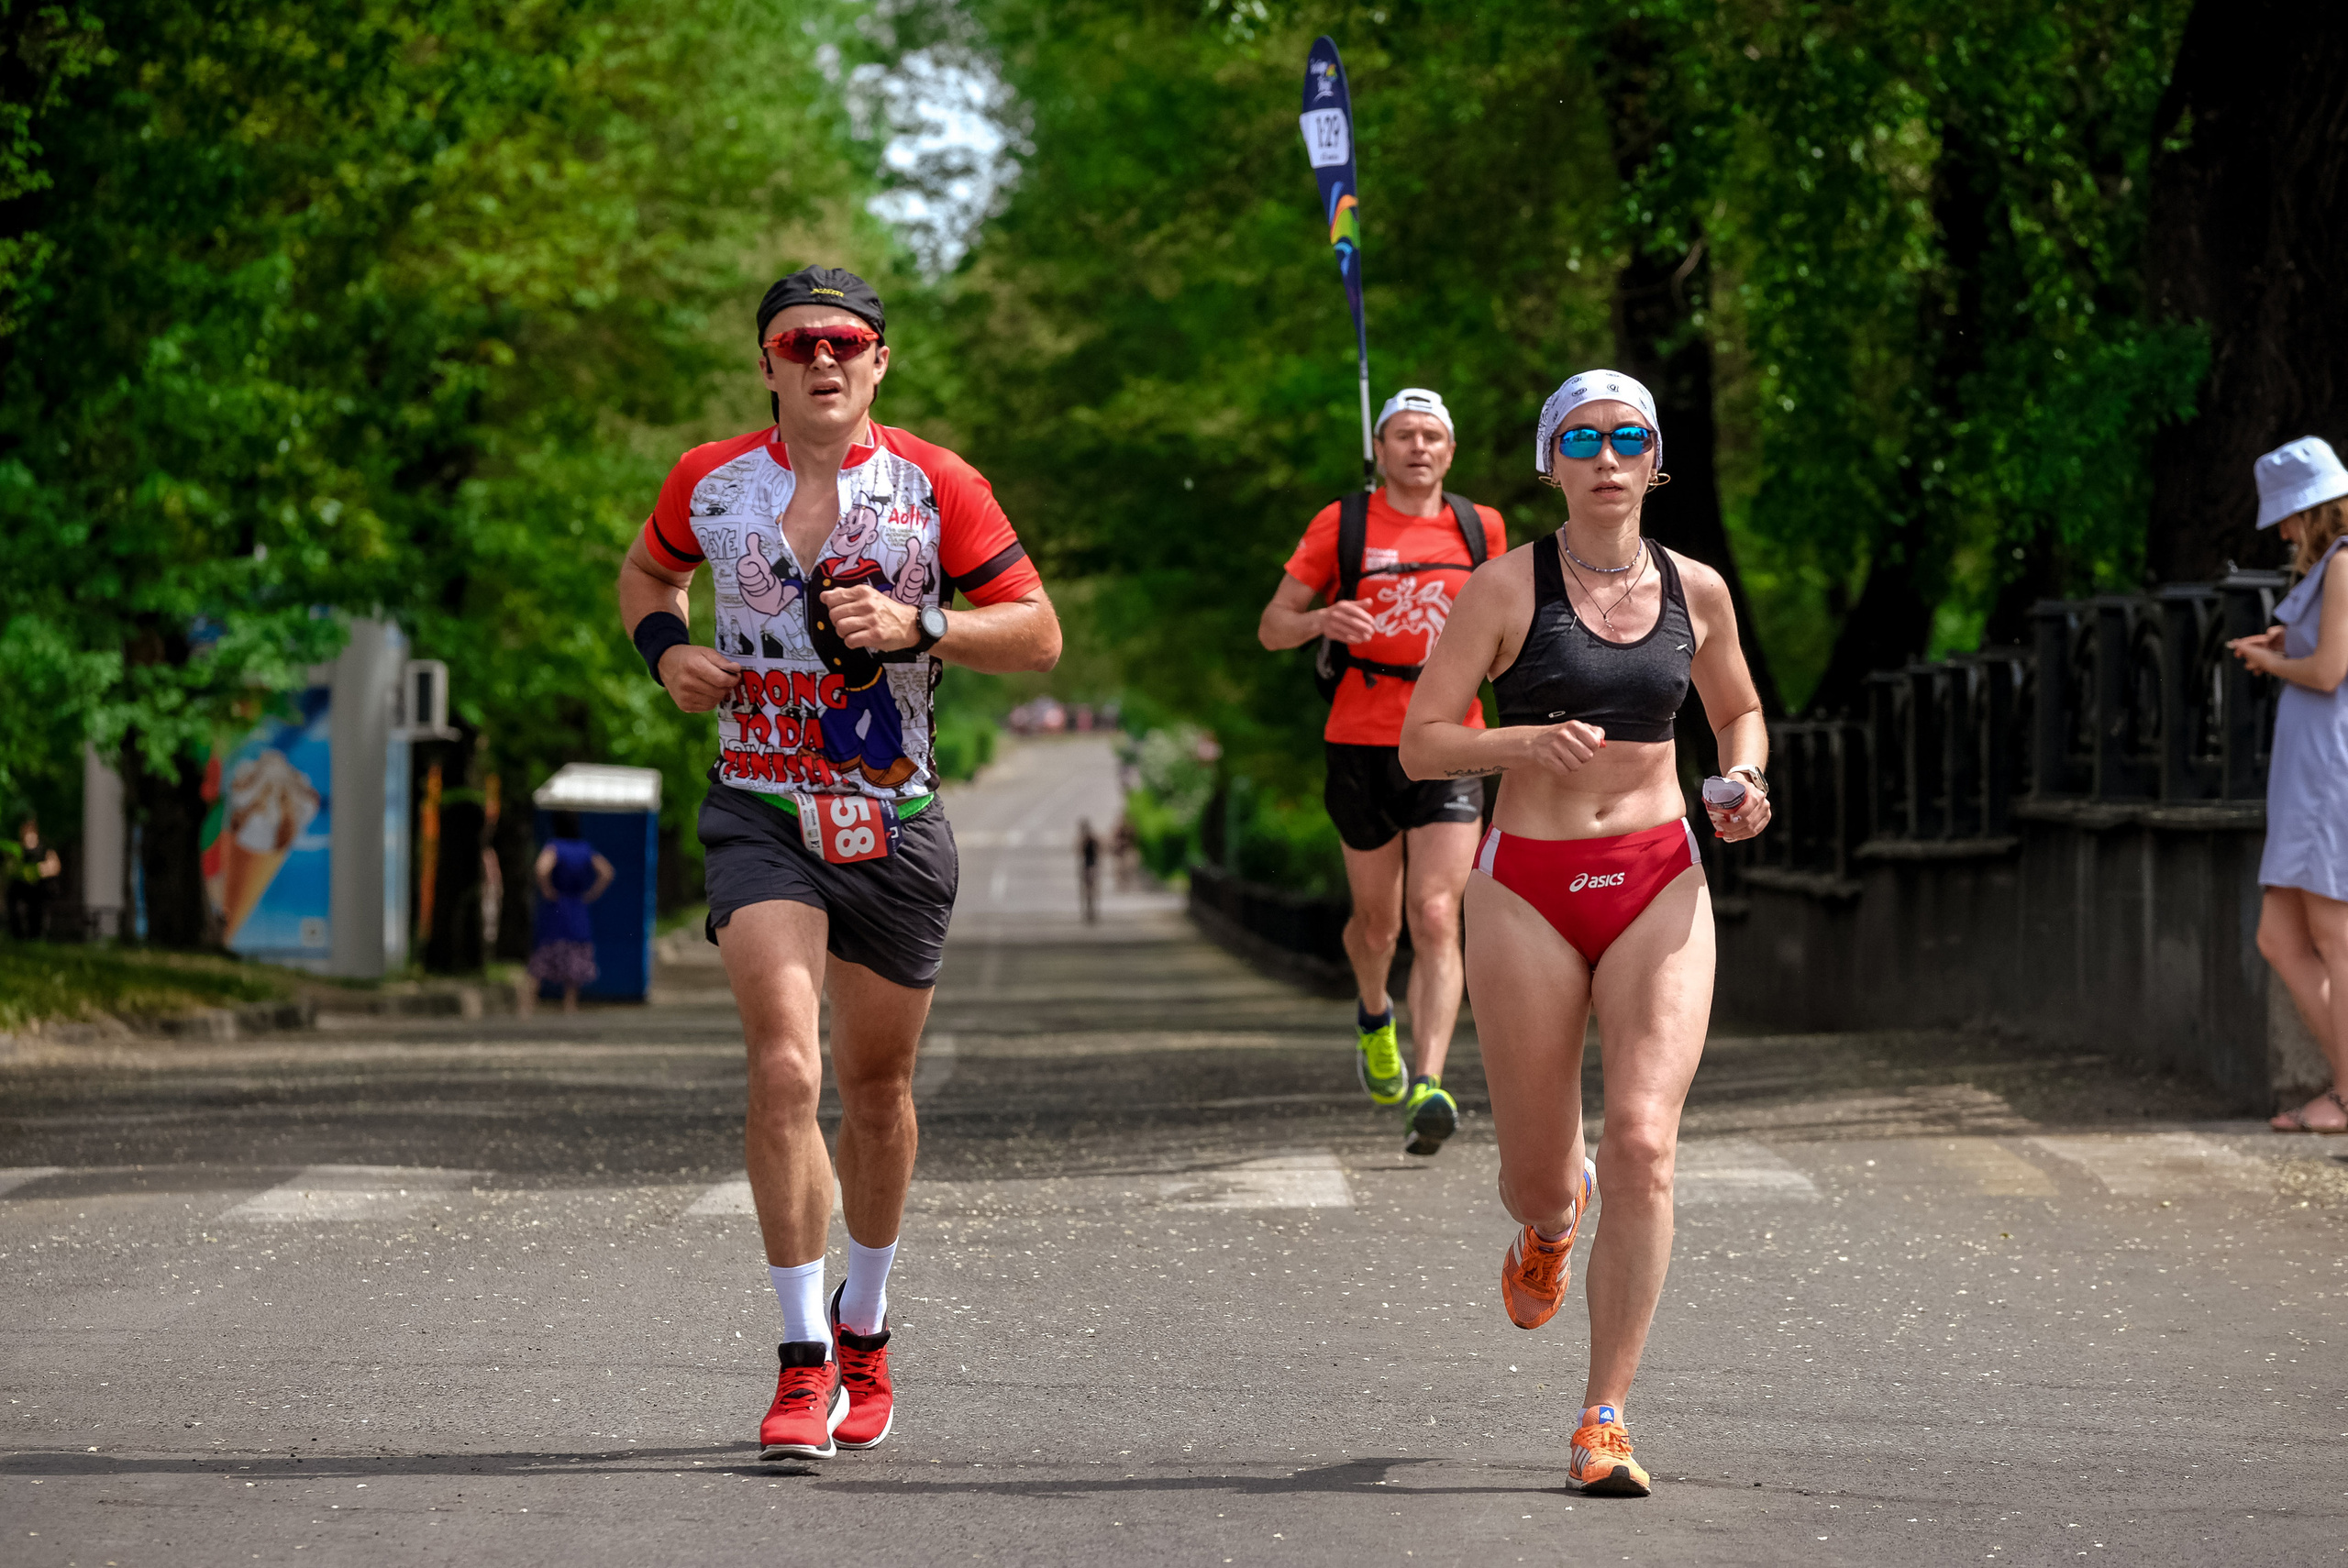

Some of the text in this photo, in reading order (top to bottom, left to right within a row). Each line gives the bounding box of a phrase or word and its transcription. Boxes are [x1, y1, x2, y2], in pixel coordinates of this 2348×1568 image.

[733, 712, 771, 745] TO
[775, 713, 825, 749] DA
[830, 796, 875, 857] 58
